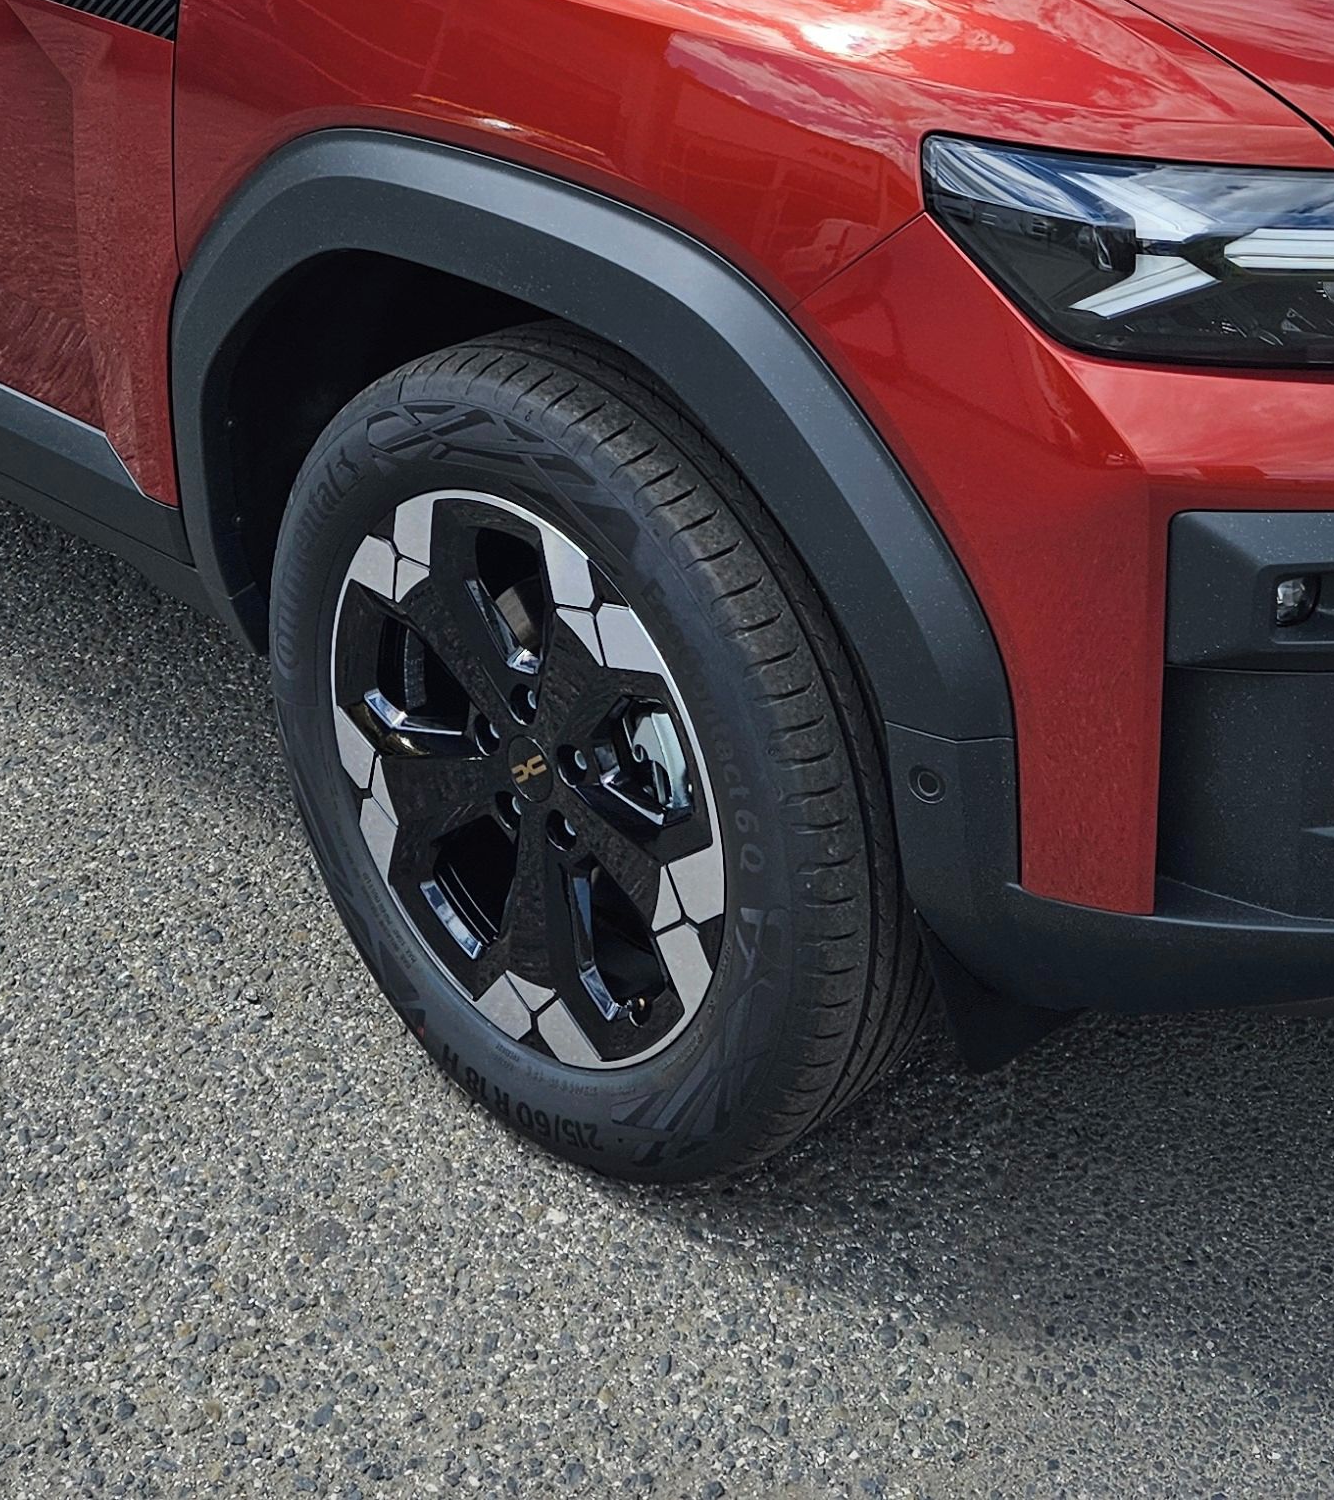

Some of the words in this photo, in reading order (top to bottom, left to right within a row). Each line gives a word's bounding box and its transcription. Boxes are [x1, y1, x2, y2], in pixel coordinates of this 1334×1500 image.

[465, 1066, 488, 1100] 18
[493, 1085, 510, 1118] R
[516, 1101, 605, 1152] 215/60
